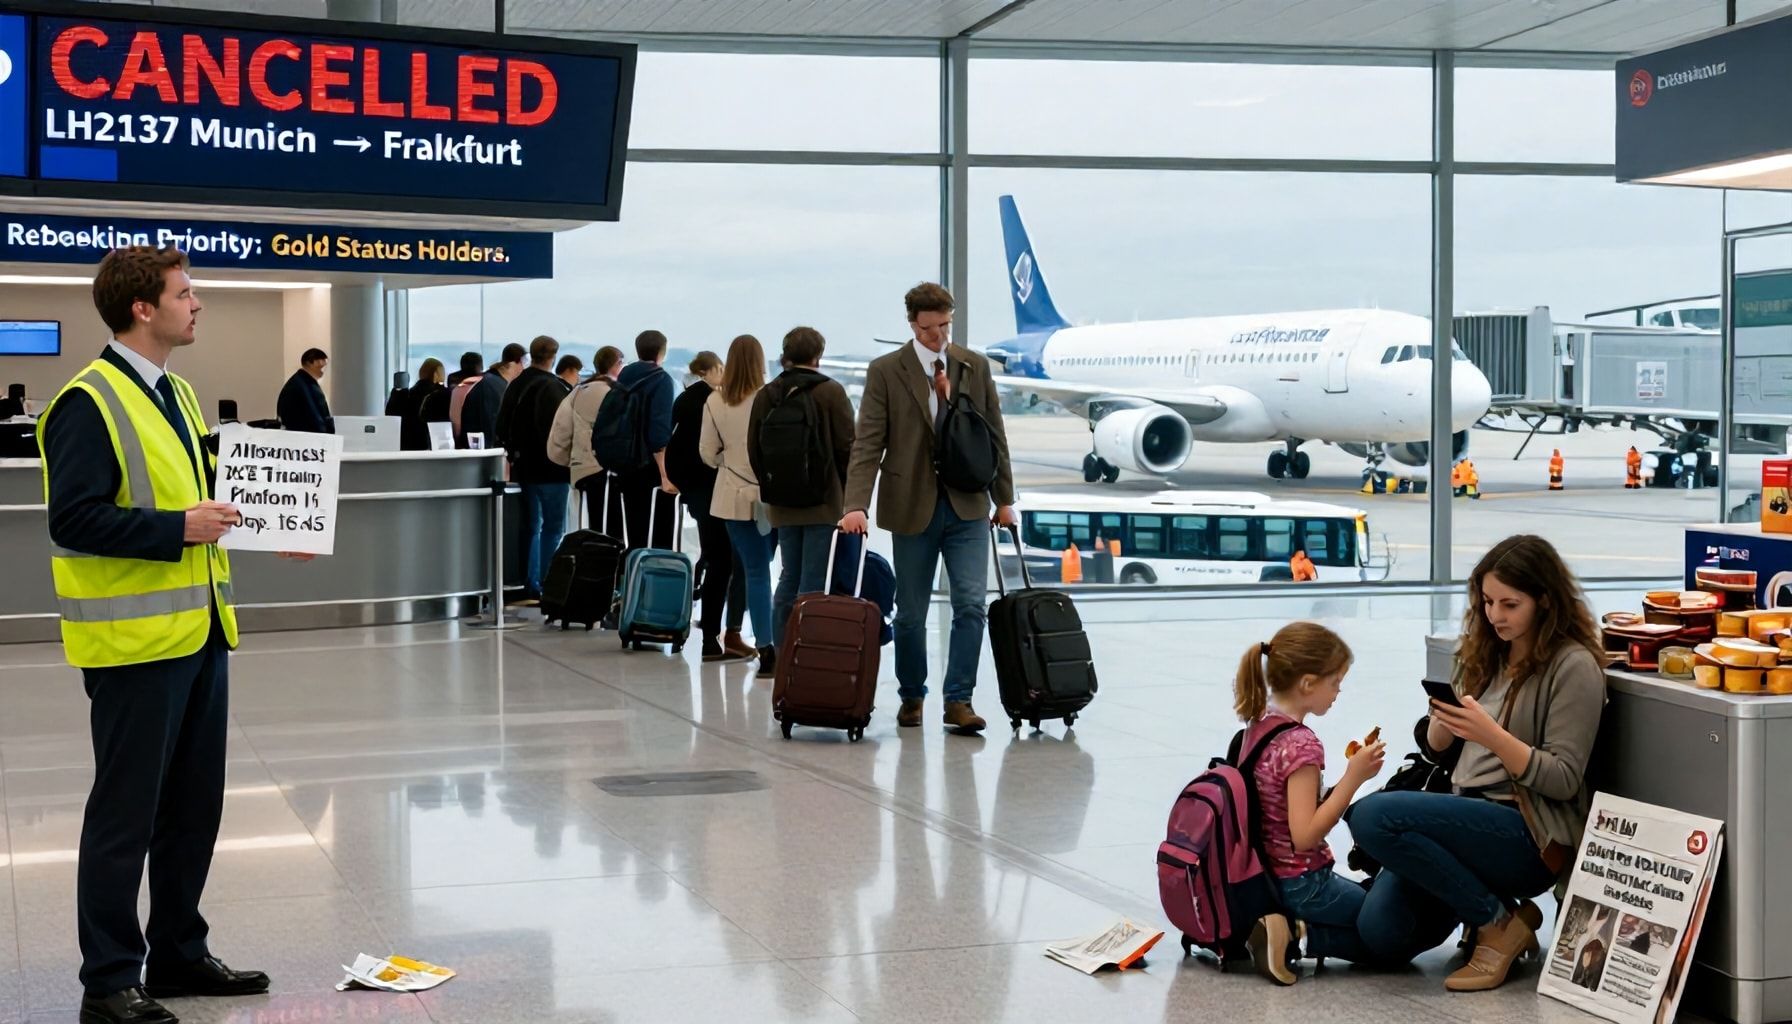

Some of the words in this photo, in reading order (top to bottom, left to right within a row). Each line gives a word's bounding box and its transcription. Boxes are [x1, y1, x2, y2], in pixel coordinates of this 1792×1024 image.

[51, 26, 558, 126] CANCELLED
[46, 108, 179, 144] LH2137
[190, 117, 316, 153] Munich
[271, 233, 330, 258] Gold
[335, 236, 413, 260] Status
